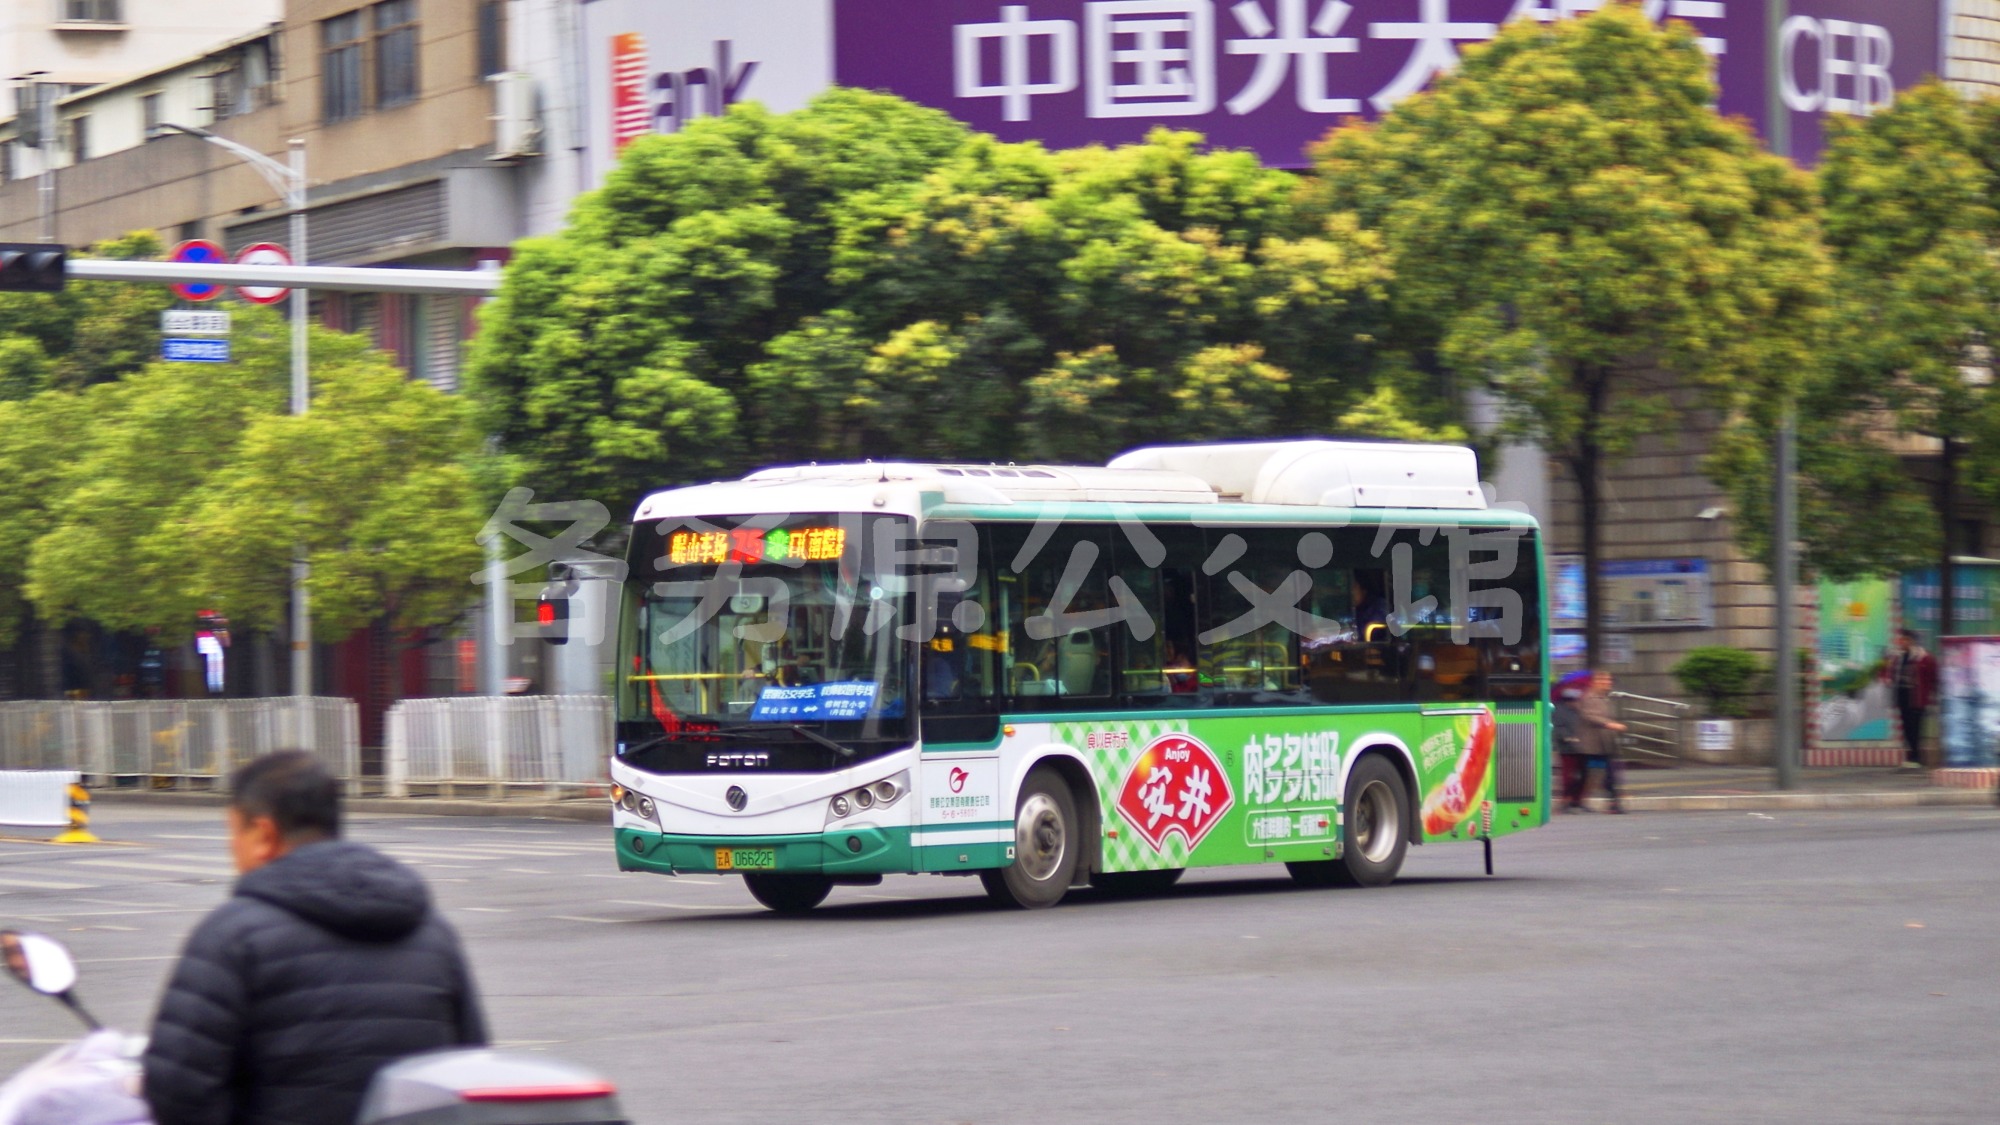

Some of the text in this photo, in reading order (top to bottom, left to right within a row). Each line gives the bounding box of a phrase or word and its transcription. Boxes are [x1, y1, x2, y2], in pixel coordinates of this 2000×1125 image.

[1780, 15, 1894, 115] CEB
[731, 529, 764, 564] 75
[706, 754, 769, 767] FOTON
[1165, 745, 1191, 763] Anjoy
[1137, 765, 1212, 830] 安井
